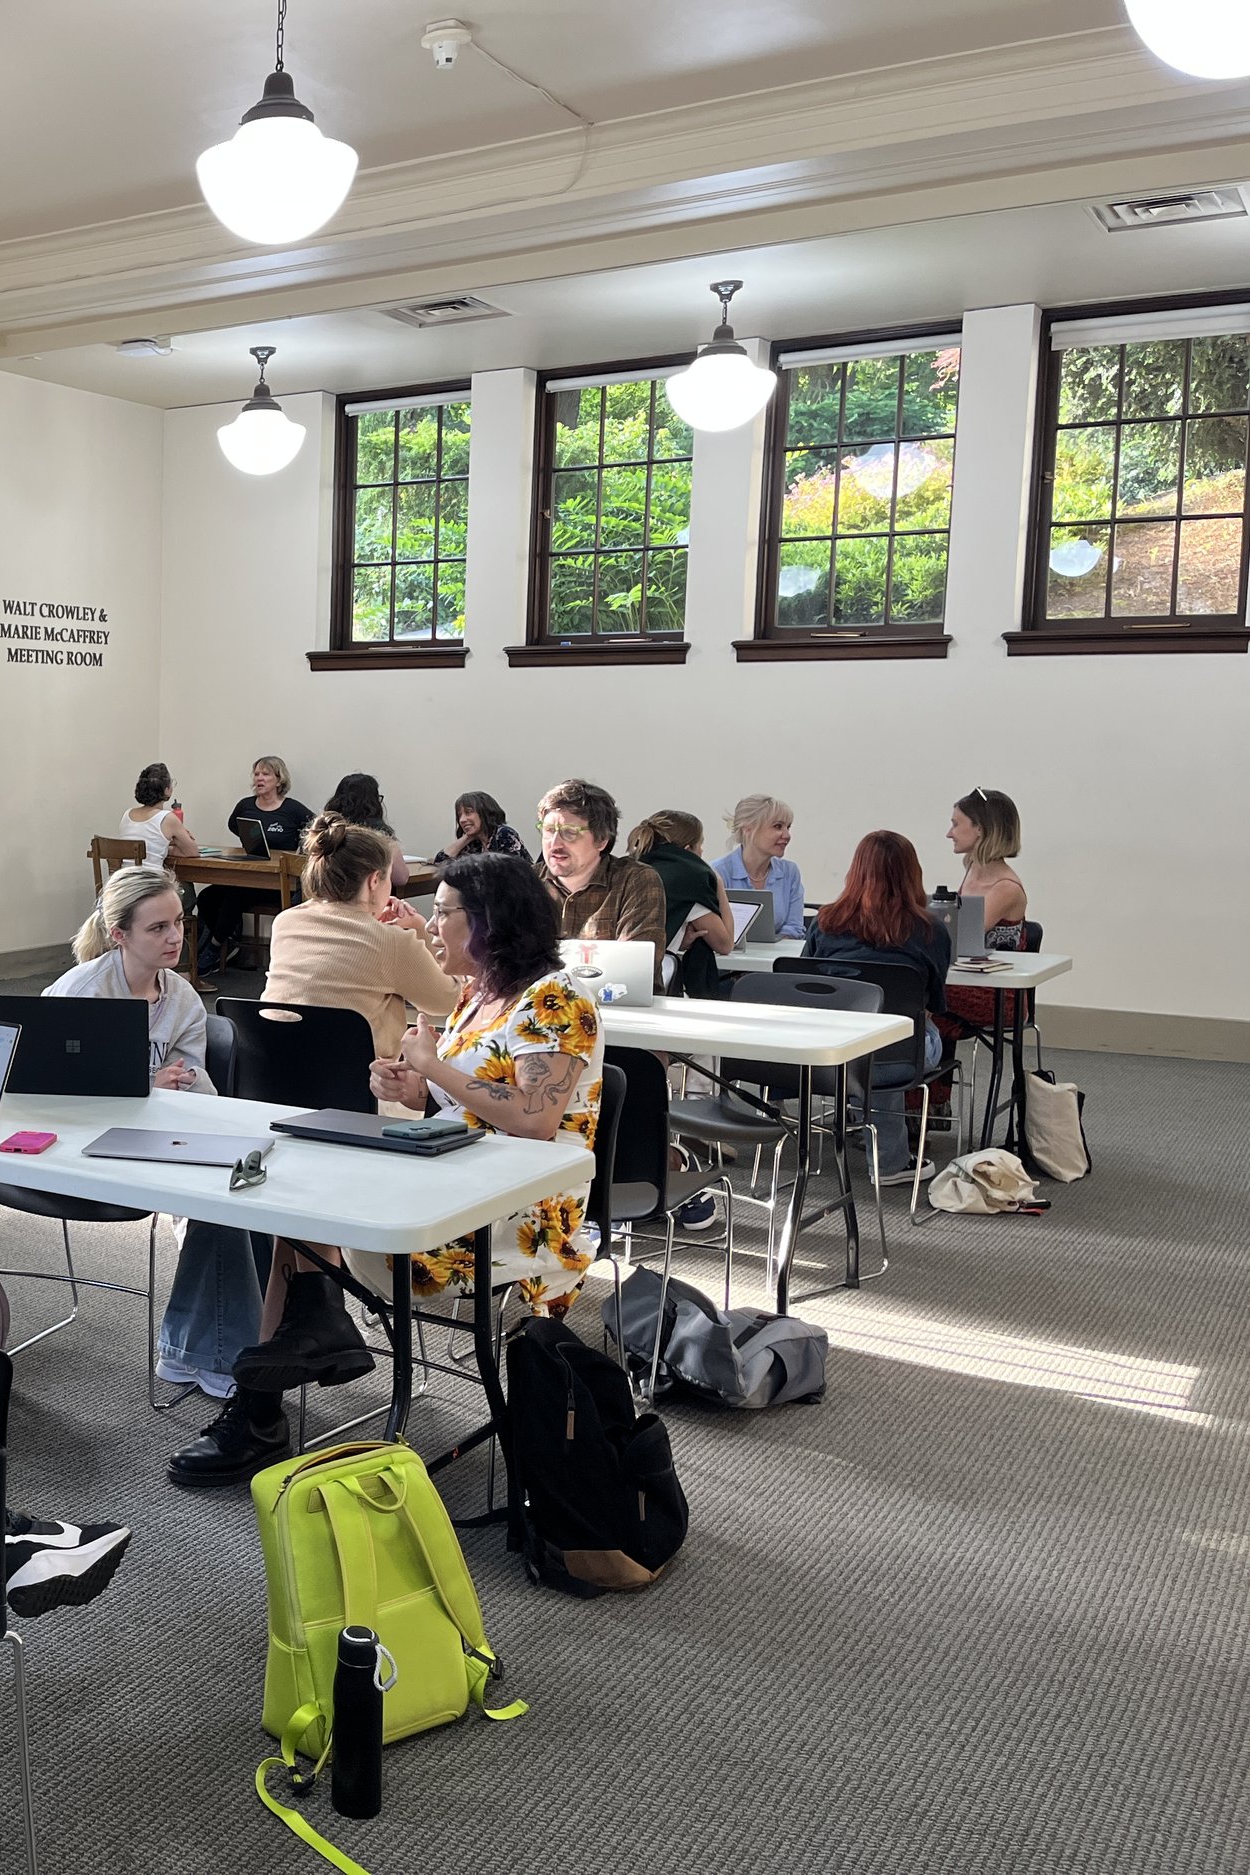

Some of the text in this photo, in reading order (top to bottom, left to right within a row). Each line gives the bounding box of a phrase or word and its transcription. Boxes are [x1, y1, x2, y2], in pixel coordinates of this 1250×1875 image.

[2, 599, 108, 623] WALT CROWLEY &
[0, 622, 110, 645] MARIE McCAFFREY
[6, 647, 103, 667] MEETING ROOM
